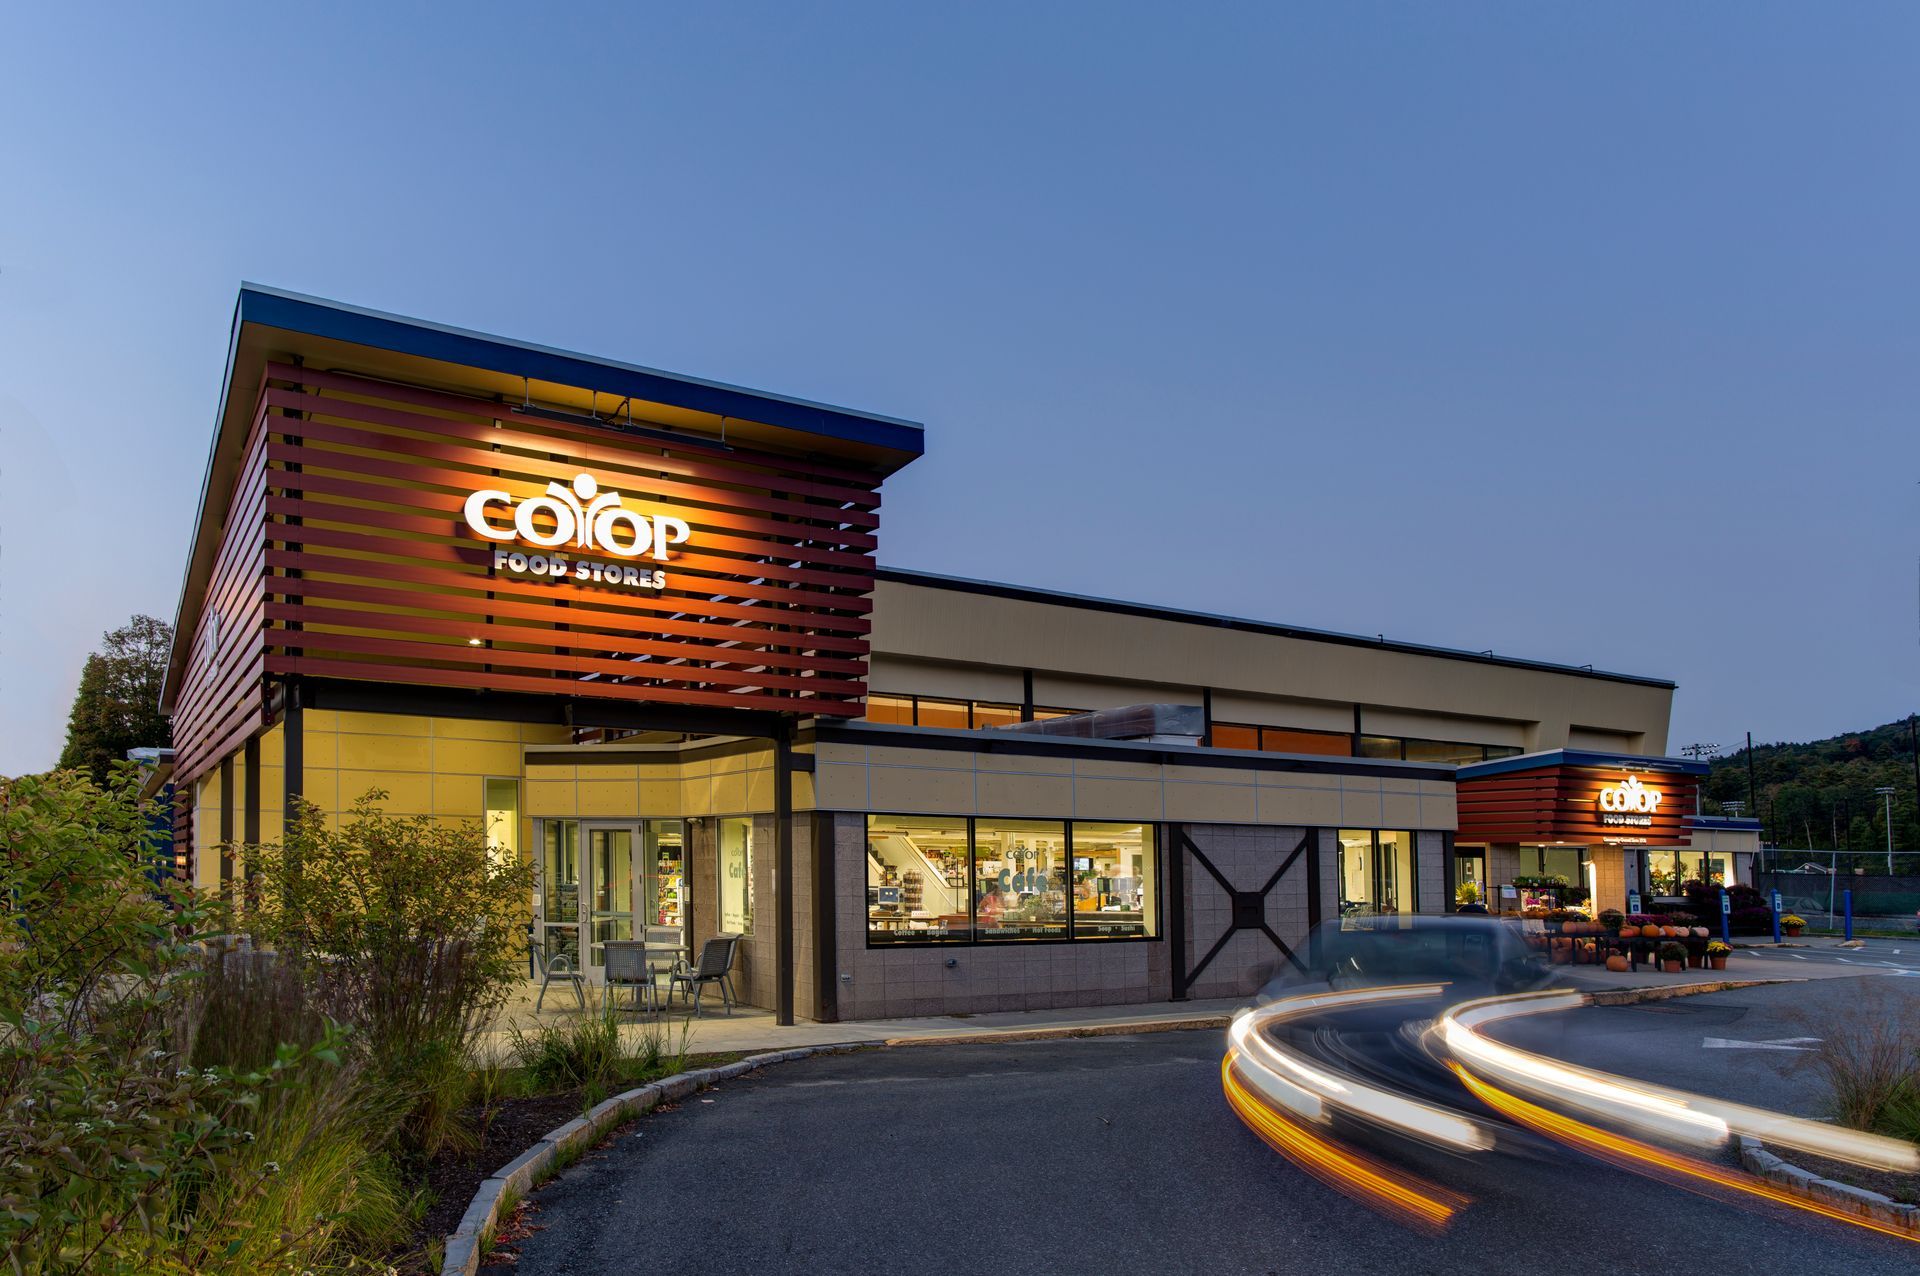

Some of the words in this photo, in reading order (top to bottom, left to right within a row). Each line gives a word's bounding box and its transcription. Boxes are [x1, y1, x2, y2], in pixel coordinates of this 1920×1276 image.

[494, 550, 567, 577] FOOD
[575, 560, 666, 590] STORES
[1603, 814, 1625, 825] FOOD
[998, 866, 1048, 893] Café
[926, 929, 949, 937] Bagels
[984, 926, 1021, 935] Sandwiches
